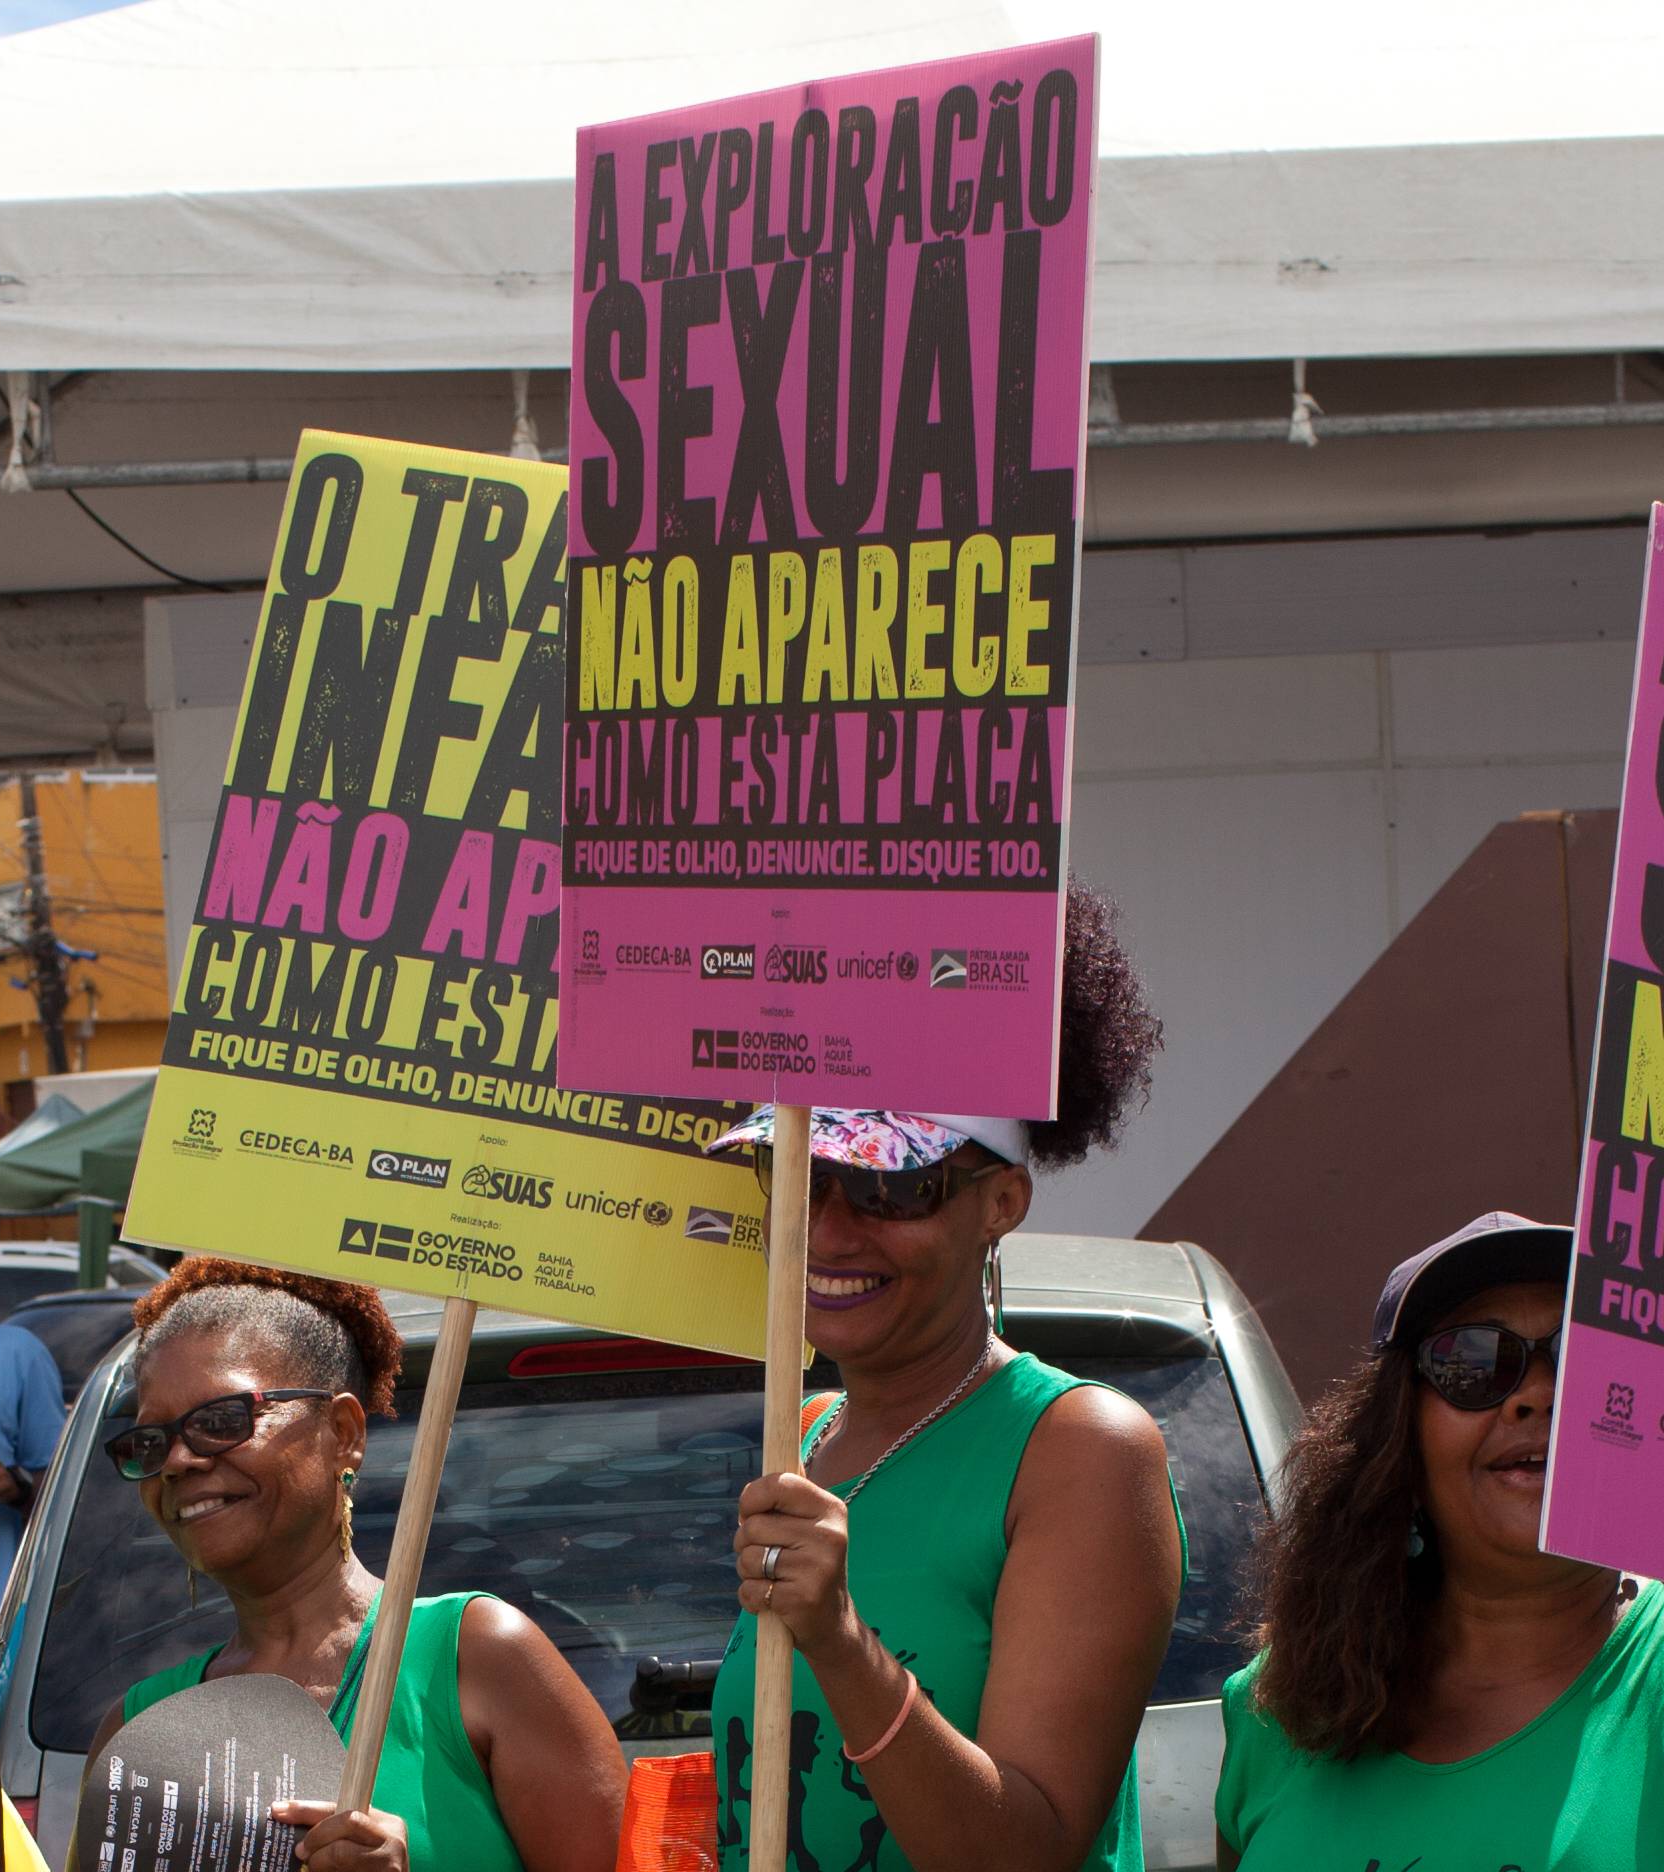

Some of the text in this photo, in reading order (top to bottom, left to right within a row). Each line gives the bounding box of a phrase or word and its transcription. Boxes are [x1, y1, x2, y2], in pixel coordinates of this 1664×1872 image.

[583, 69, 1075, 296] A EXPLORAÇÃO
[578, 229, 1074, 562] SEXUAL
[278, 453, 366, 600] O
[580, 557, 700, 713] NÃO
[717, 534, 1046, 707] APARECE
[565, 706, 1055, 827] COMO ESTA PLACA
[203, 794, 411, 943] NÃO
[575, 840, 1043, 883] FIQUE DE OLHO, DENUNCIE. DISQUE 100.
[617, 945, 691, 967] CEDECA-BA
[722, 950, 752, 967] PLAN
[782, 948, 829, 983] SUAS
[838, 951, 895, 979] unicef
[179, 925, 403, 1043] COMO
[968, 963, 1029, 985] BRASIL
[740, 1031, 808, 1052] GOVERNO
[740, 1052, 816, 1074] DO ESTADO
[190, 1029, 629, 1132] FIQUE DE OLHO, DENUNCIE.
[239, 1130, 354, 1164] CEDECA-BA
[401, 1159, 447, 1179] PLAN
[488, 1172, 554, 1209] SUAS
[566, 1190, 641, 1220] unicef
[417, 1231, 515, 1261] GOVERNO
[413, 1248, 522, 1281] DO ESTADO
